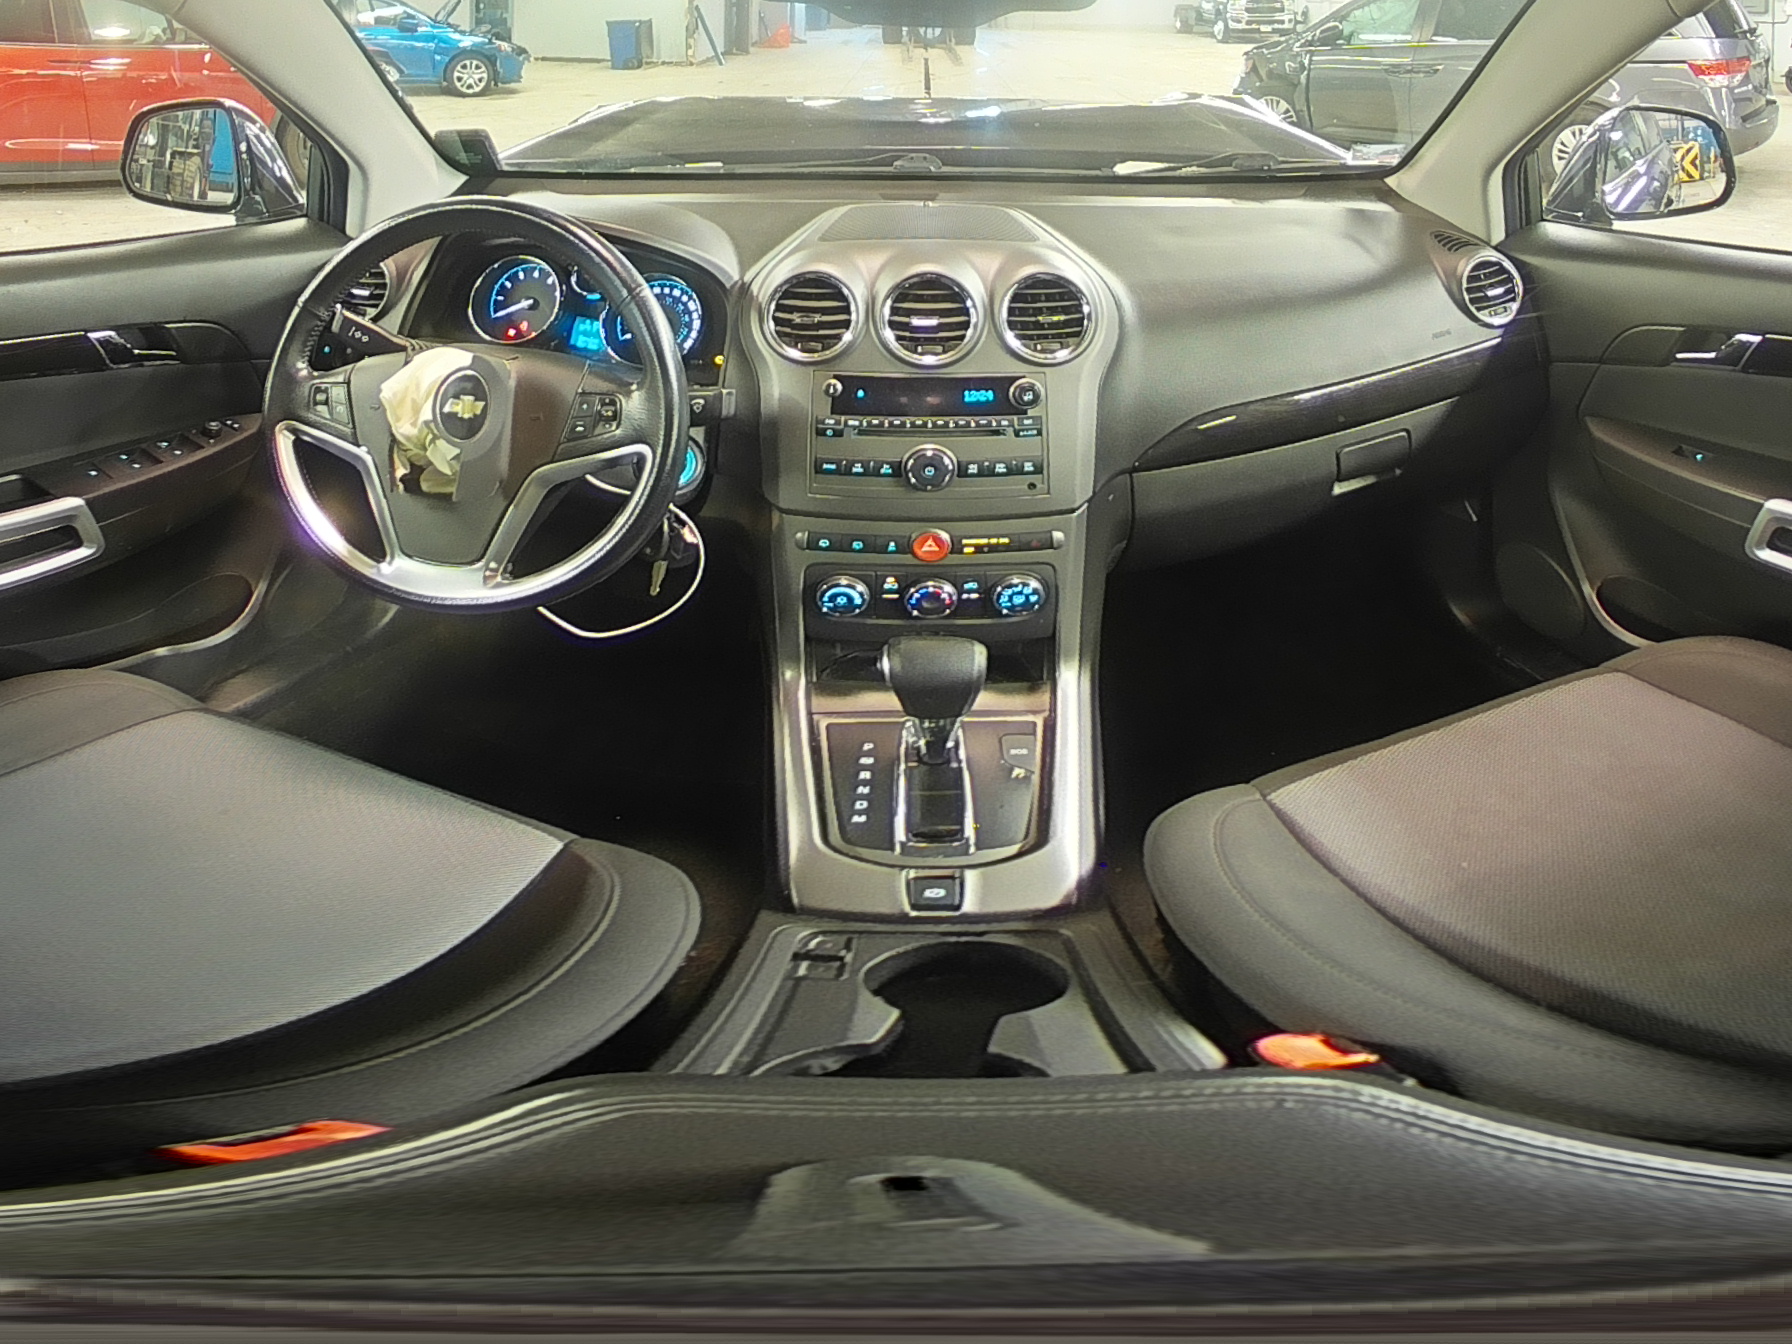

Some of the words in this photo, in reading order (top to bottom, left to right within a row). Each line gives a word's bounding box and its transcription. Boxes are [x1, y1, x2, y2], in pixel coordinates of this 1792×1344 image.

[862, 742, 874, 751] P
[856, 785, 870, 794] N
[854, 800, 868, 810] D
[851, 814, 867, 823] M
